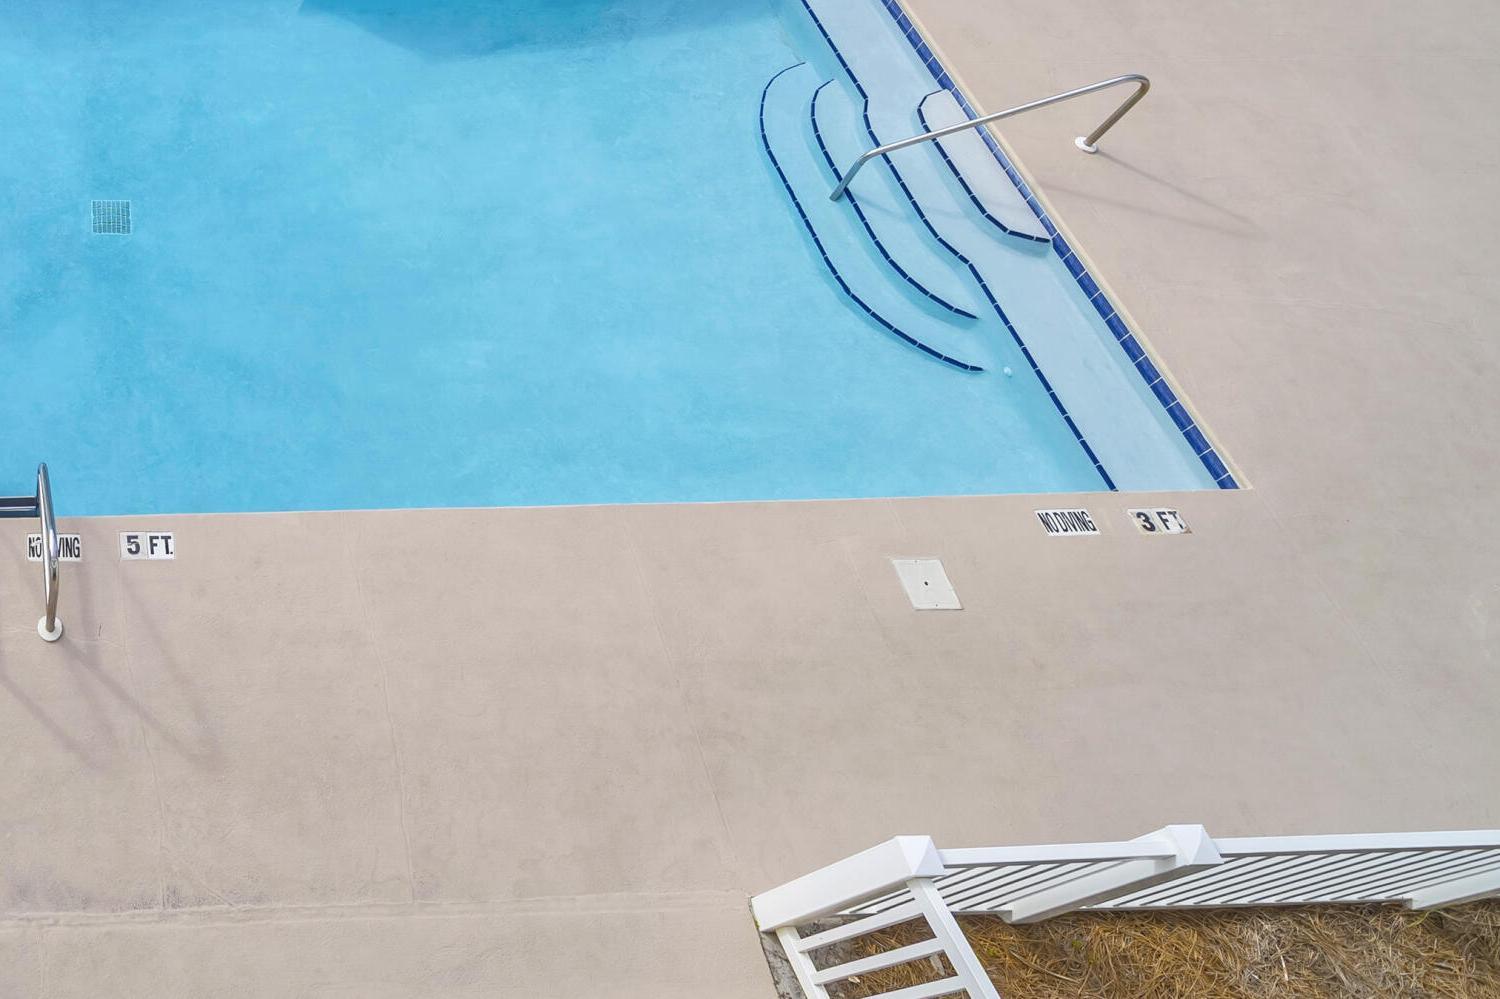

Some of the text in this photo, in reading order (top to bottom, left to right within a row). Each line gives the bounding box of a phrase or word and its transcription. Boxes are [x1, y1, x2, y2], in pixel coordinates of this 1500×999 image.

[1037, 510, 1098, 533] NO DIVING
[1136, 511, 1156, 533] 3
[28, 536, 81, 559] NO VING
[126, 535, 174, 555] 5 FT.
